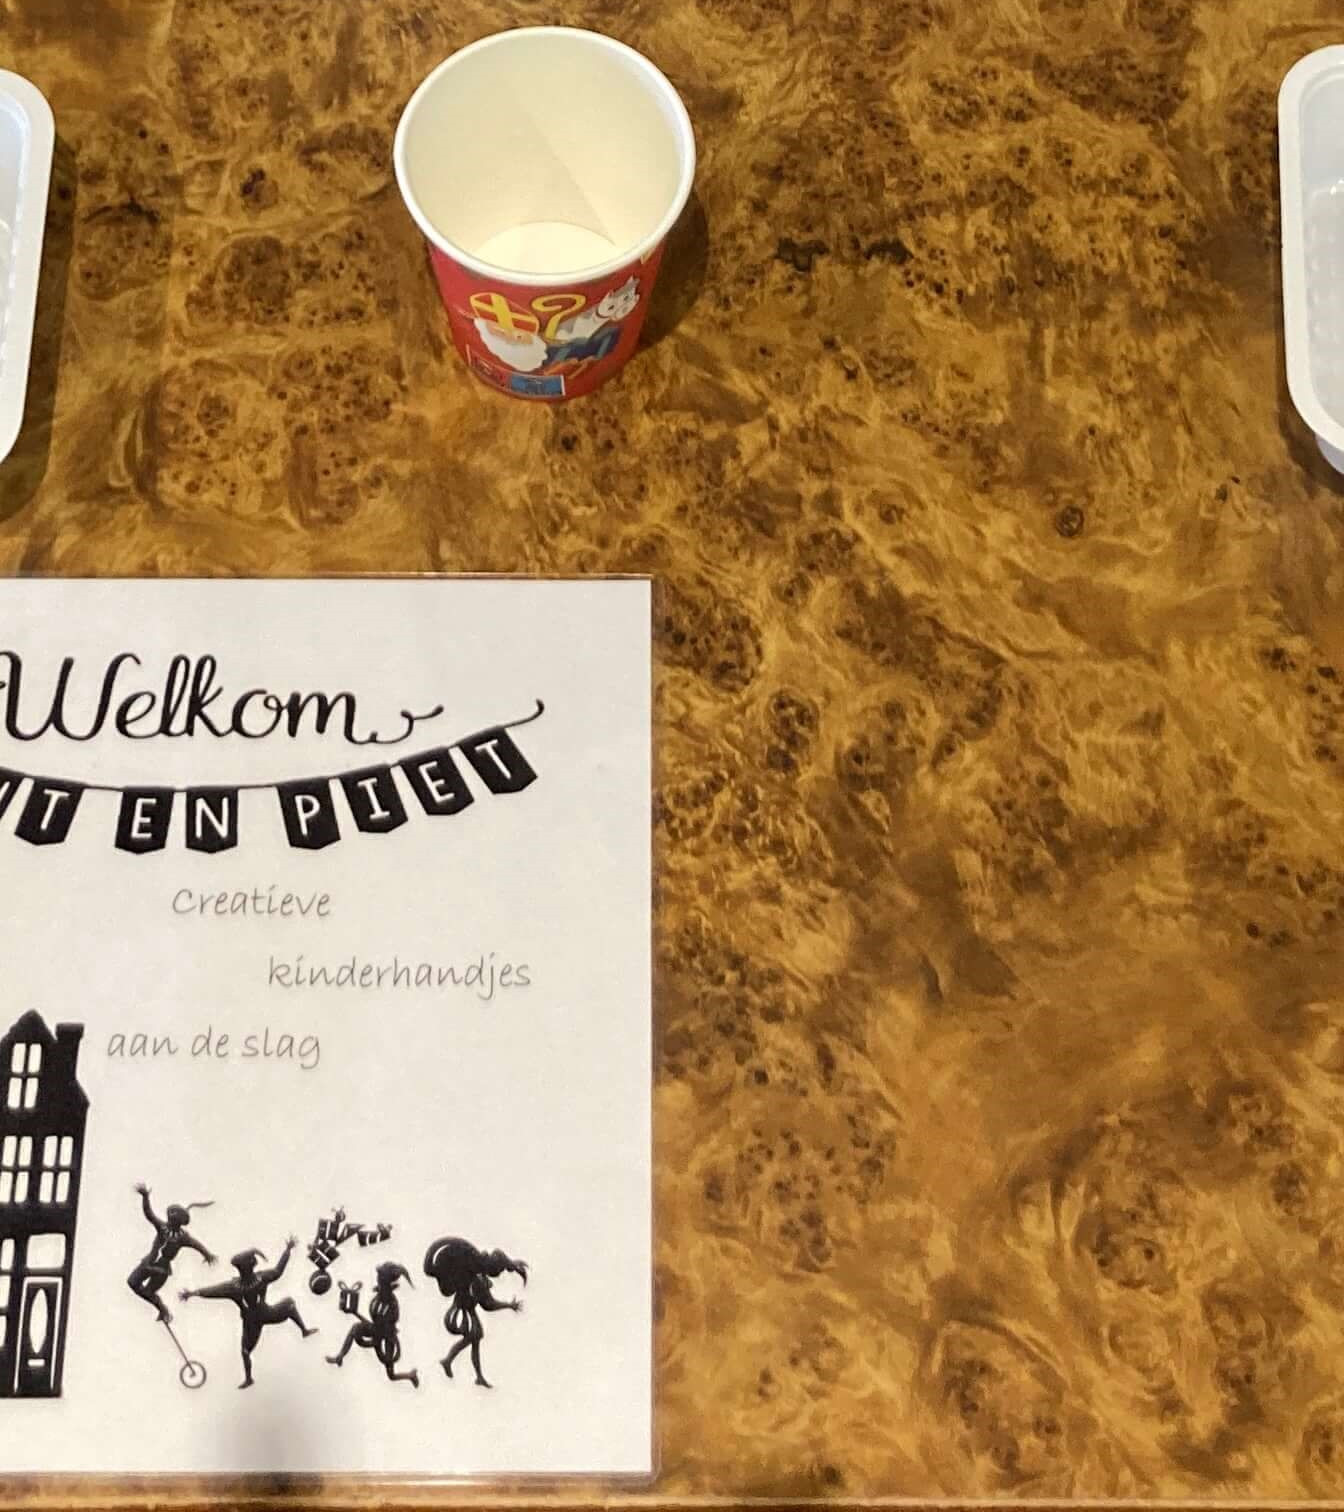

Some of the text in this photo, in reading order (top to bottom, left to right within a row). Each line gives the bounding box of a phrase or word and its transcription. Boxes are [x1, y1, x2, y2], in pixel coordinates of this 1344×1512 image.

[127, 795, 233, 842] EN
[291, 737, 516, 839] PIET
[172, 884, 332, 917] Creatieve
[268, 951, 532, 1001] kinderhandjes
[106, 1024, 322, 1070] aan de slag
